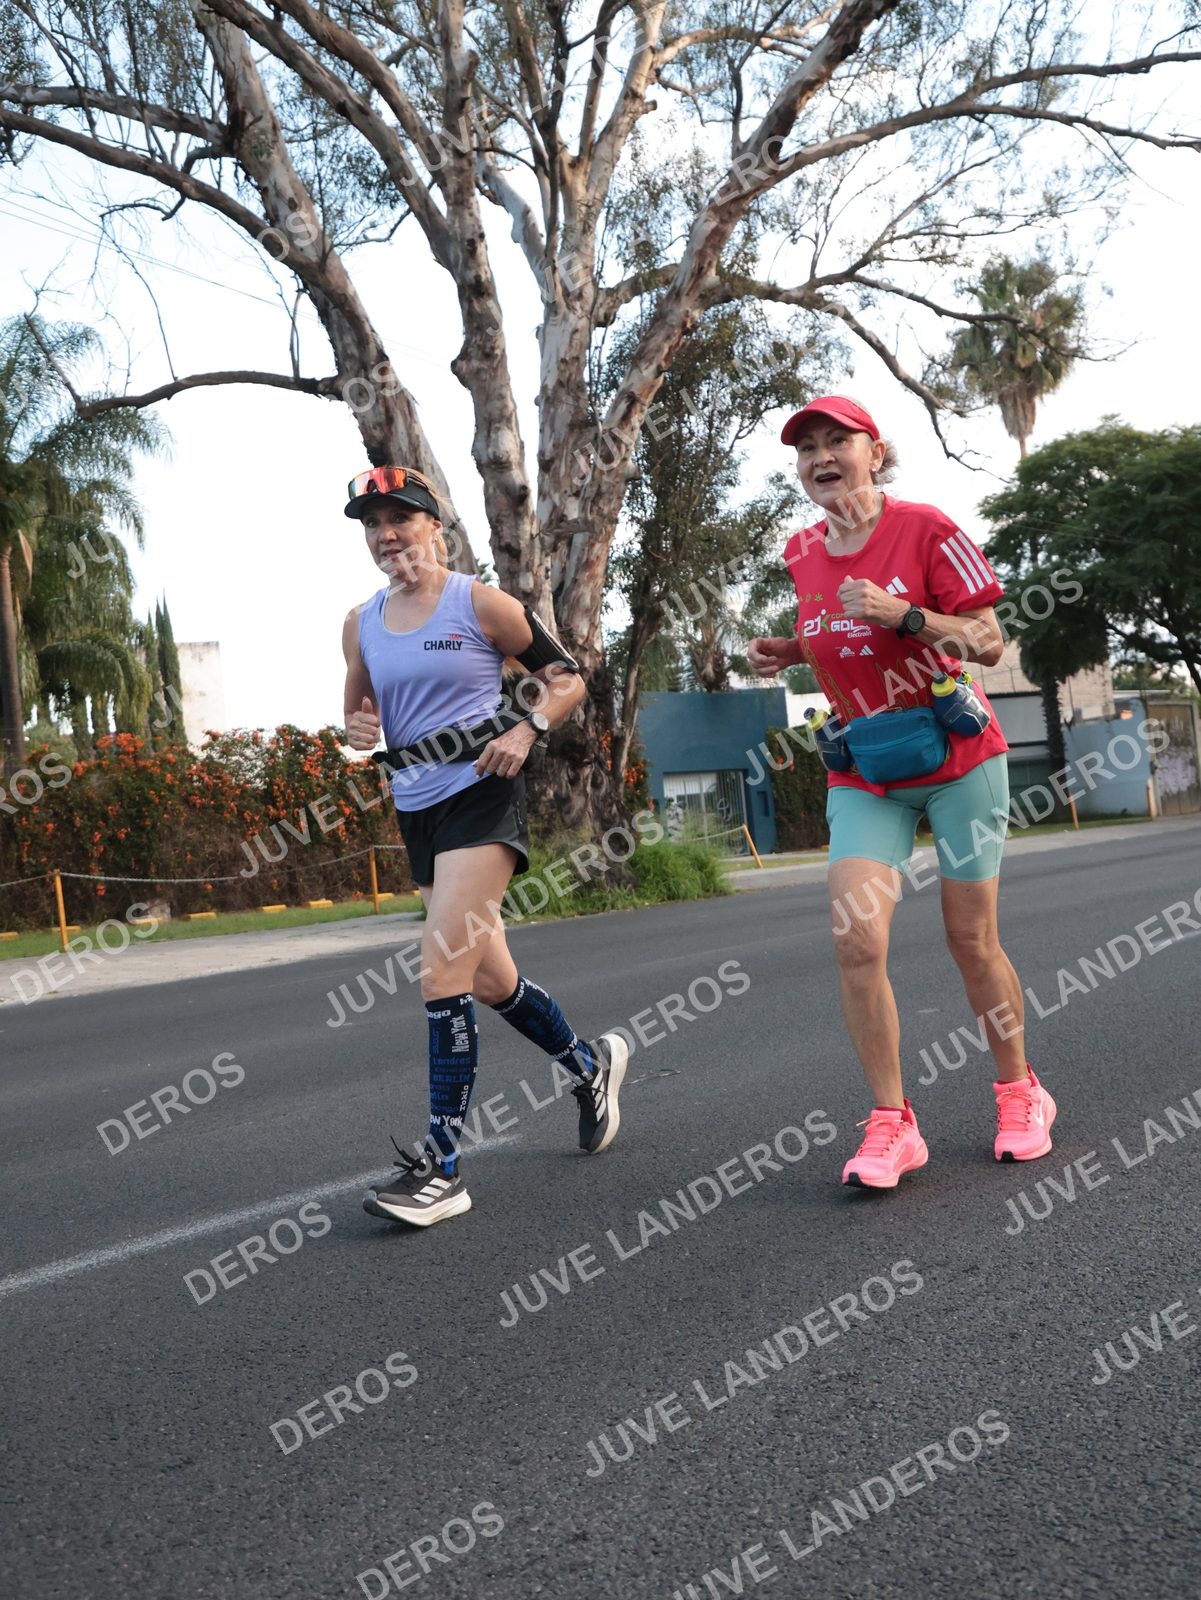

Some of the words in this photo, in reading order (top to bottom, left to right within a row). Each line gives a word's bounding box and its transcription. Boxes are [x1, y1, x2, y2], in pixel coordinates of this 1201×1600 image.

[830, 619, 857, 632] GDL
[424, 640, 463, 651] CHARLY
[442, 1115, 463, 1127] York
